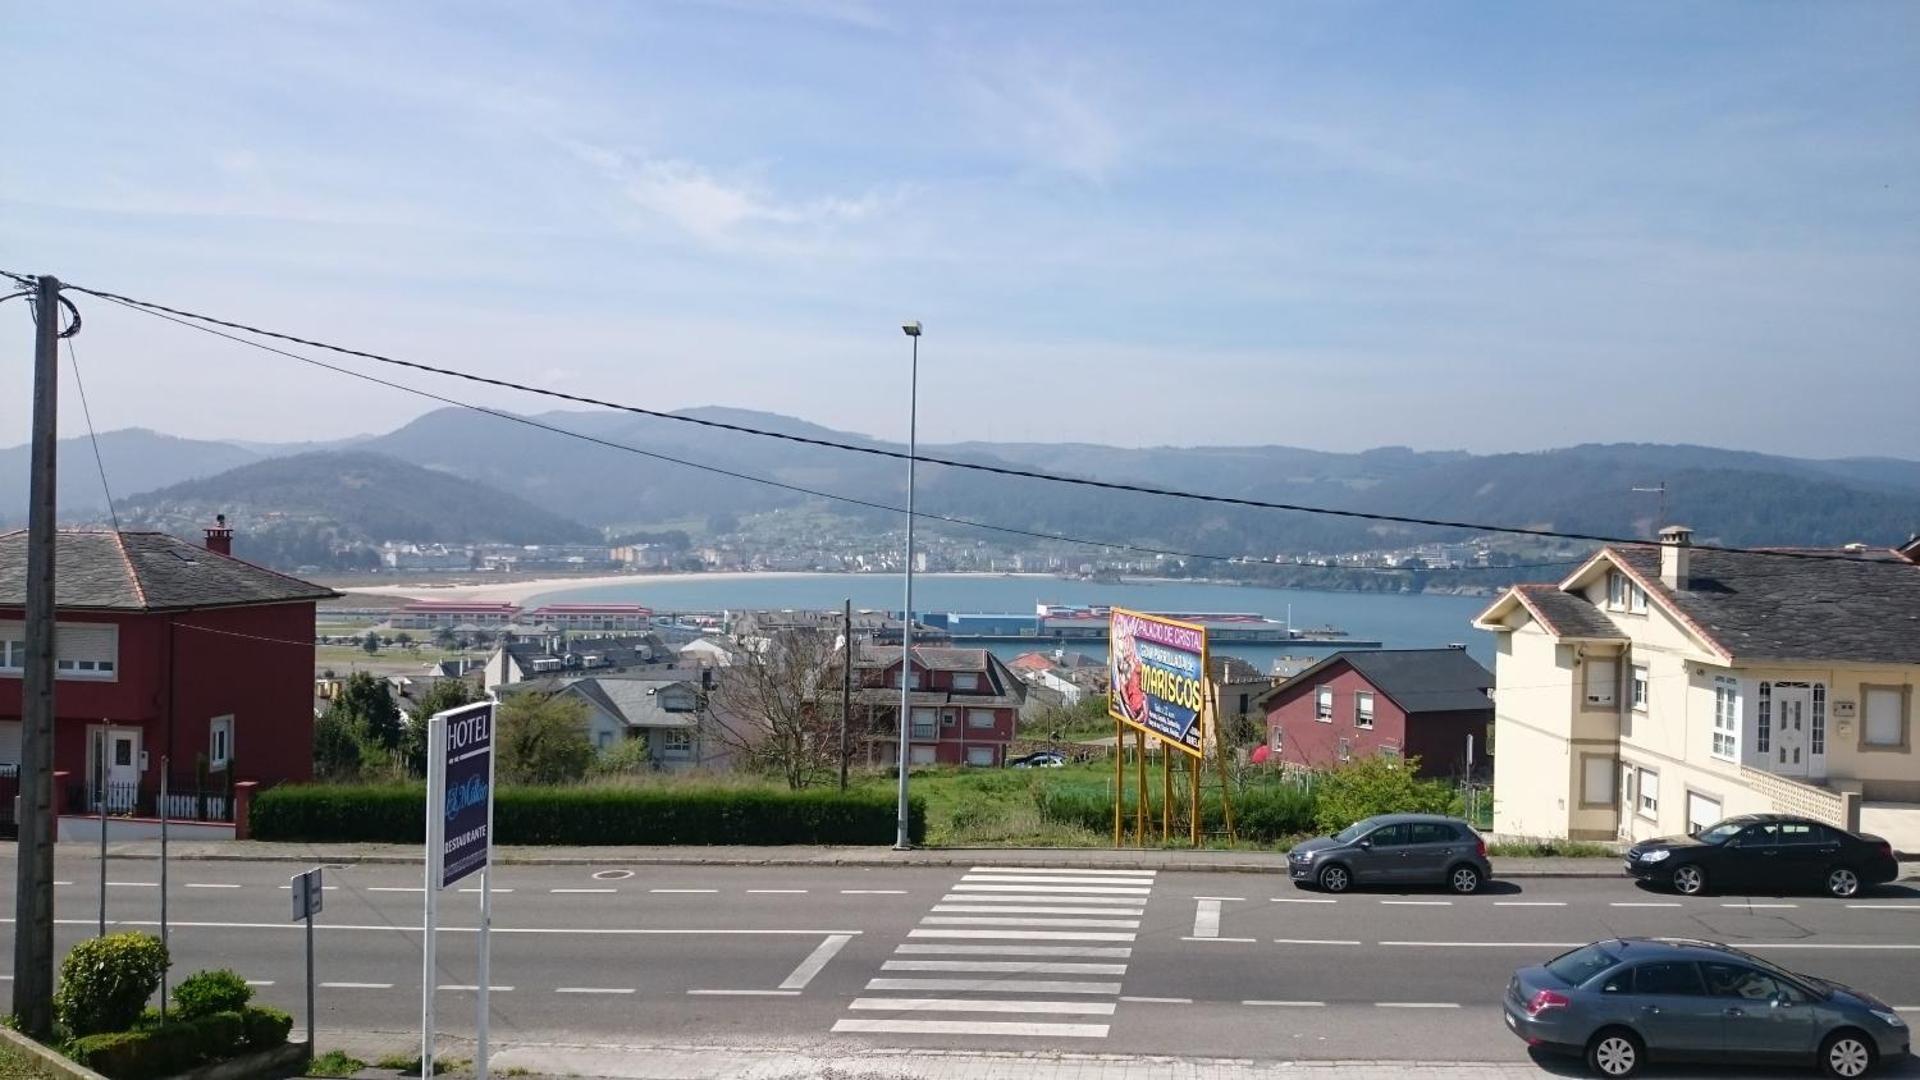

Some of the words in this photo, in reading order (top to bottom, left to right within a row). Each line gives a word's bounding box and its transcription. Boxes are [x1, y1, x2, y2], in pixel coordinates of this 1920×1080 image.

[1137, 620, 1162, 640] PALACIO
[1164, 627, 1173, 642] DE
[1174, 628, 1203, 650] CRISTAL
[1141, 664, 1201, 712] MARISCOS
[447, 714, 489, 752] HOTEL
[444, 825, 487, 855] RESTAURANTE
